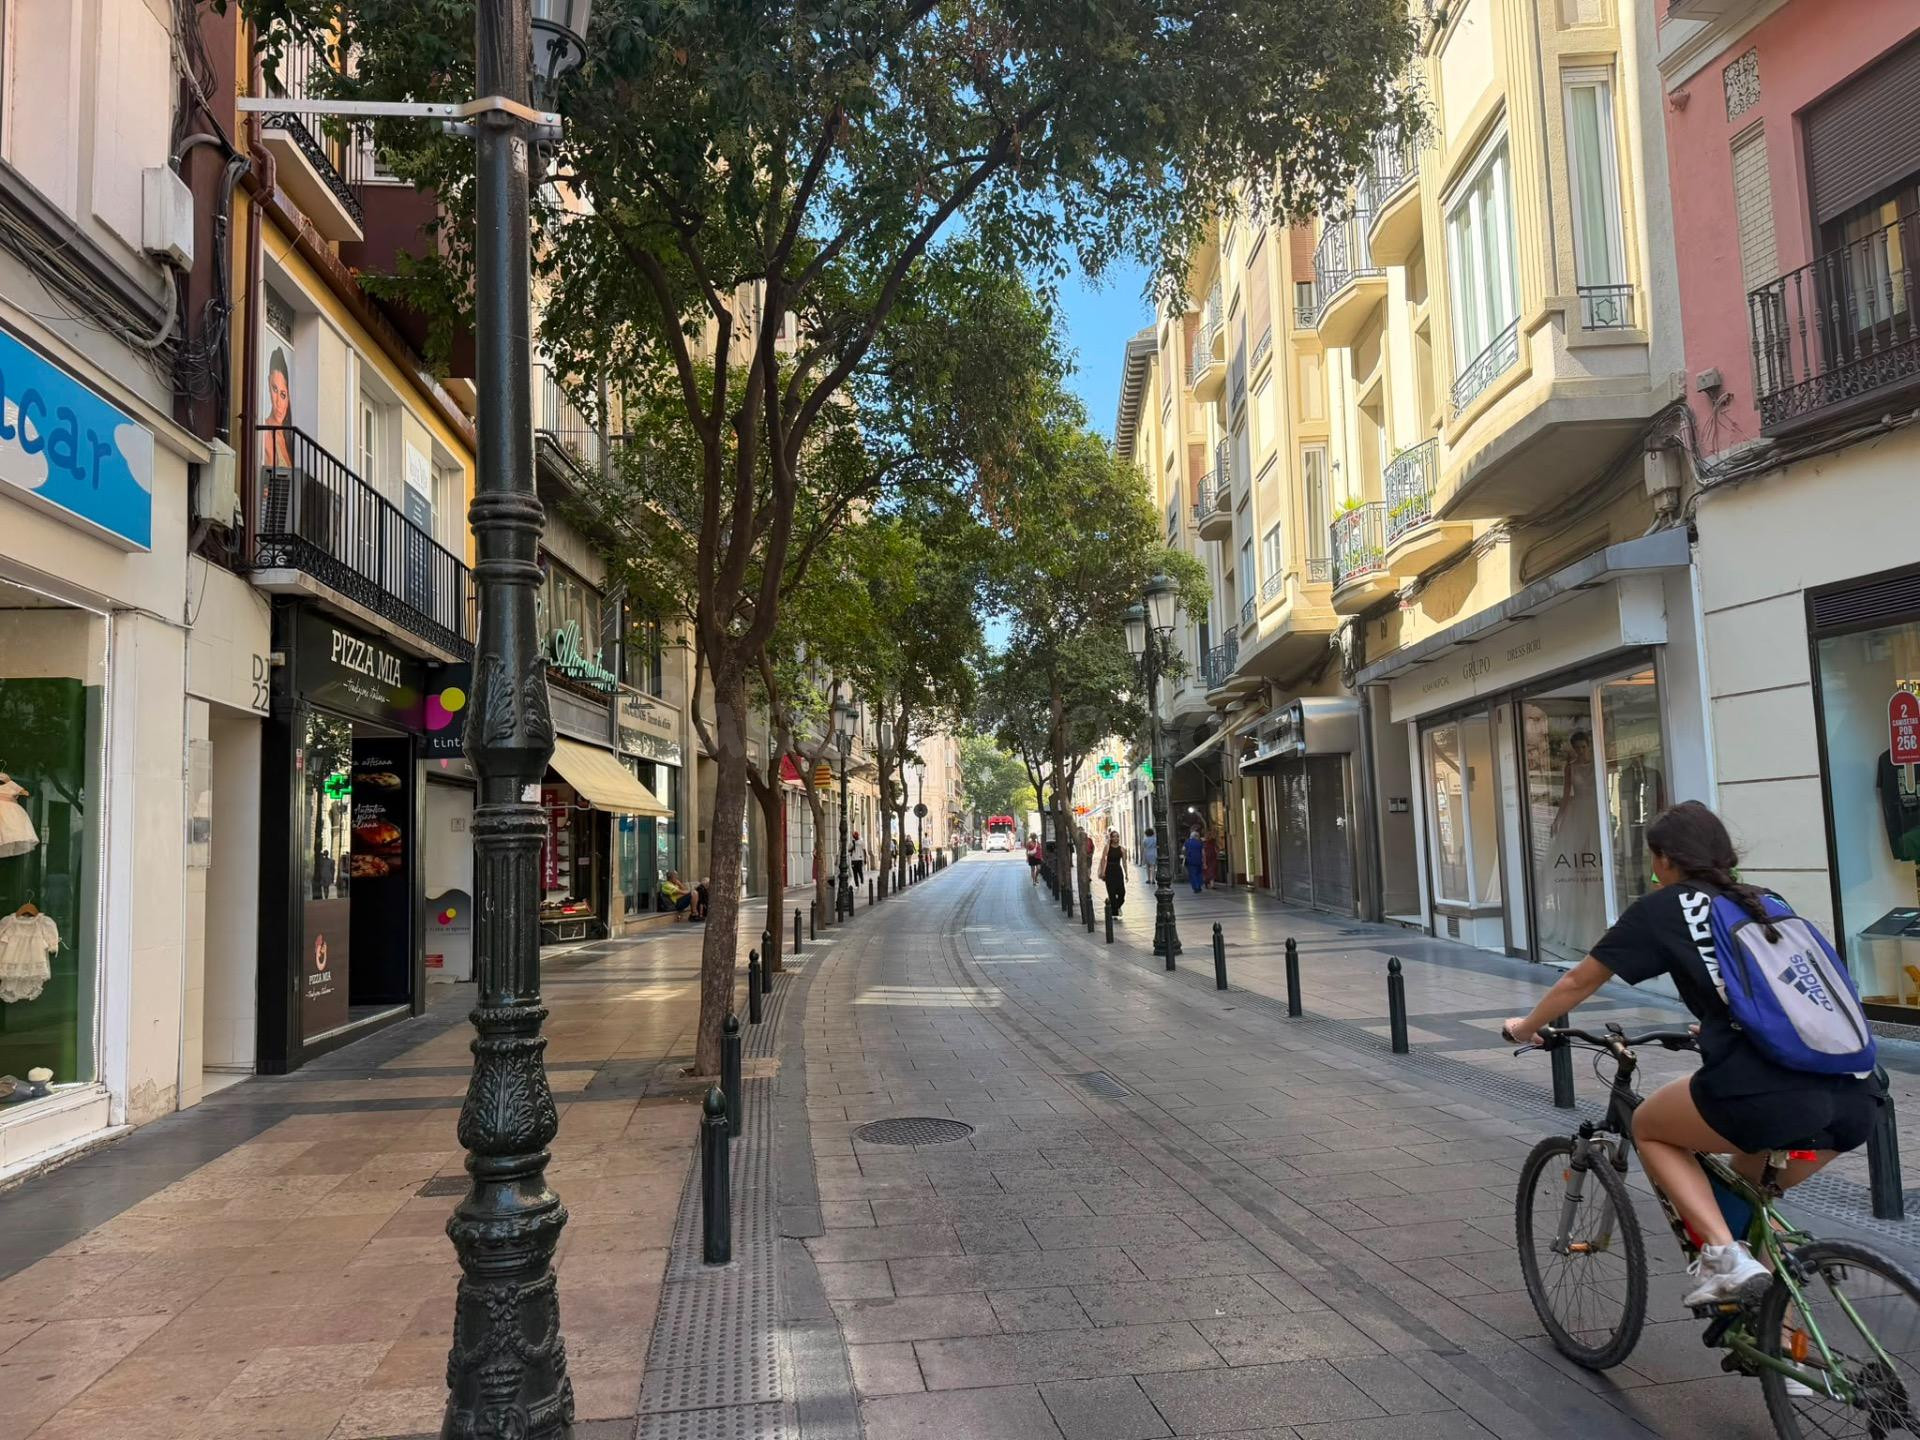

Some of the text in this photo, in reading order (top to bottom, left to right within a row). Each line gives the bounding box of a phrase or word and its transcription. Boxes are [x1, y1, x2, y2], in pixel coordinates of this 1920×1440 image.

[252, 653, 270, 685] DJ
[330, 628, 402, 689] PIZZA MIA
[252, 682, 269, 713] 22
[1900, 703, 1908, 718] 2
[433, 736, 464, 748] tint
[1898, 725, 1914, 736] POR
[1554, 852, 1603, 869] AIR
[1789, 953, 1835, 1012] adidas
